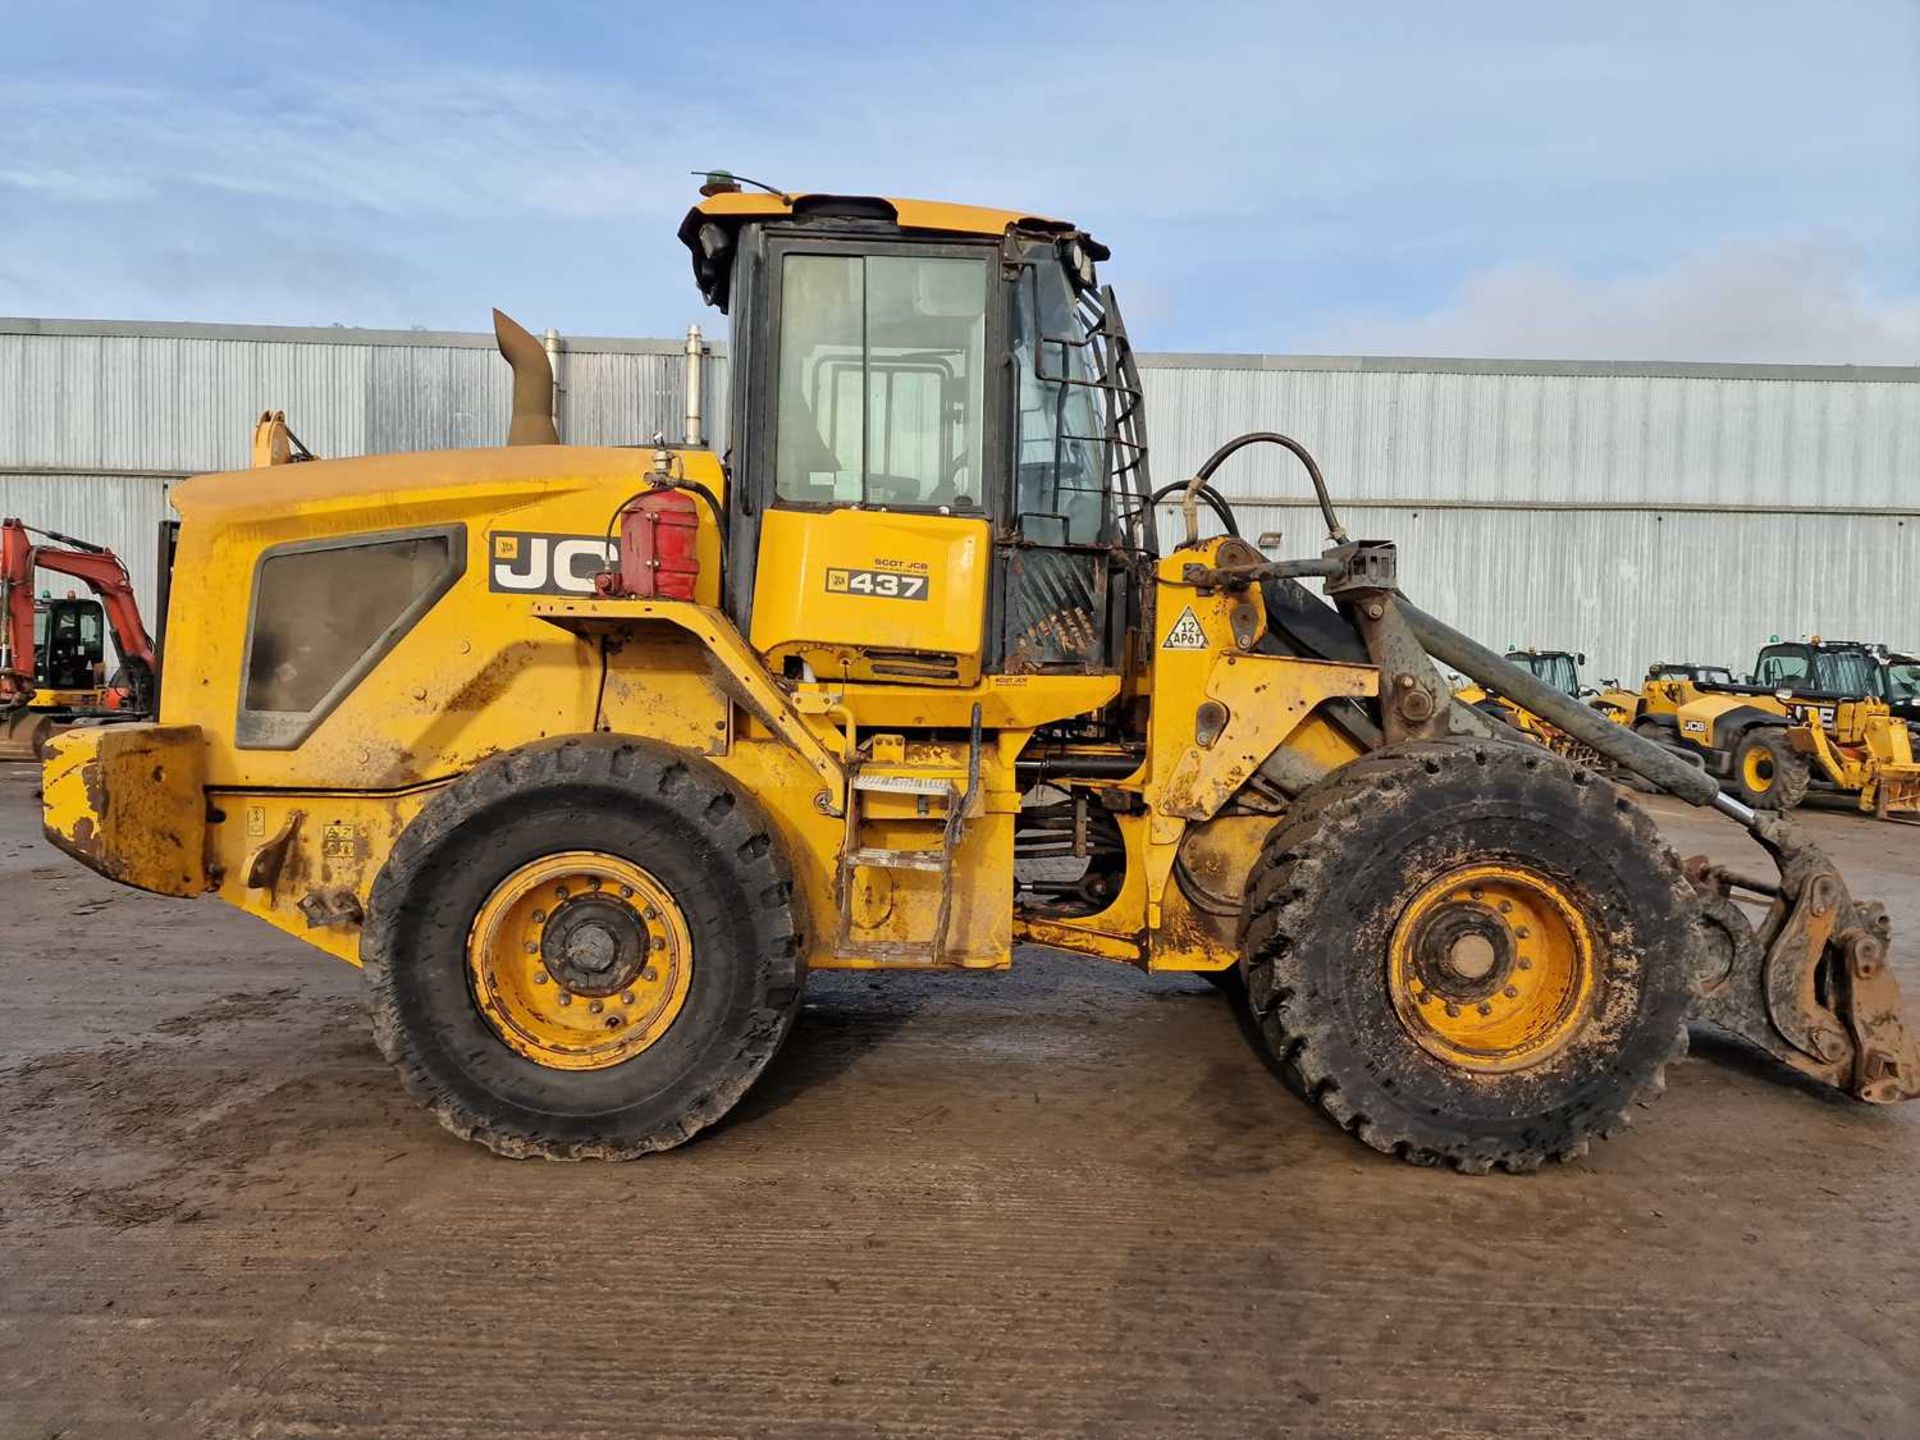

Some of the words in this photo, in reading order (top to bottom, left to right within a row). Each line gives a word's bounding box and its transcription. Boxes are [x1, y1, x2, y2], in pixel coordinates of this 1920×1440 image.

[495, 538, 619, 592] JC
[874, 558, 905, 568] SCOT
[907, 562, 928, 570] JCB
[849, 572, 924, 597] 437
[1181, 621, 1195, 633] 12
[1684, 720, 1705, 731] JCB
